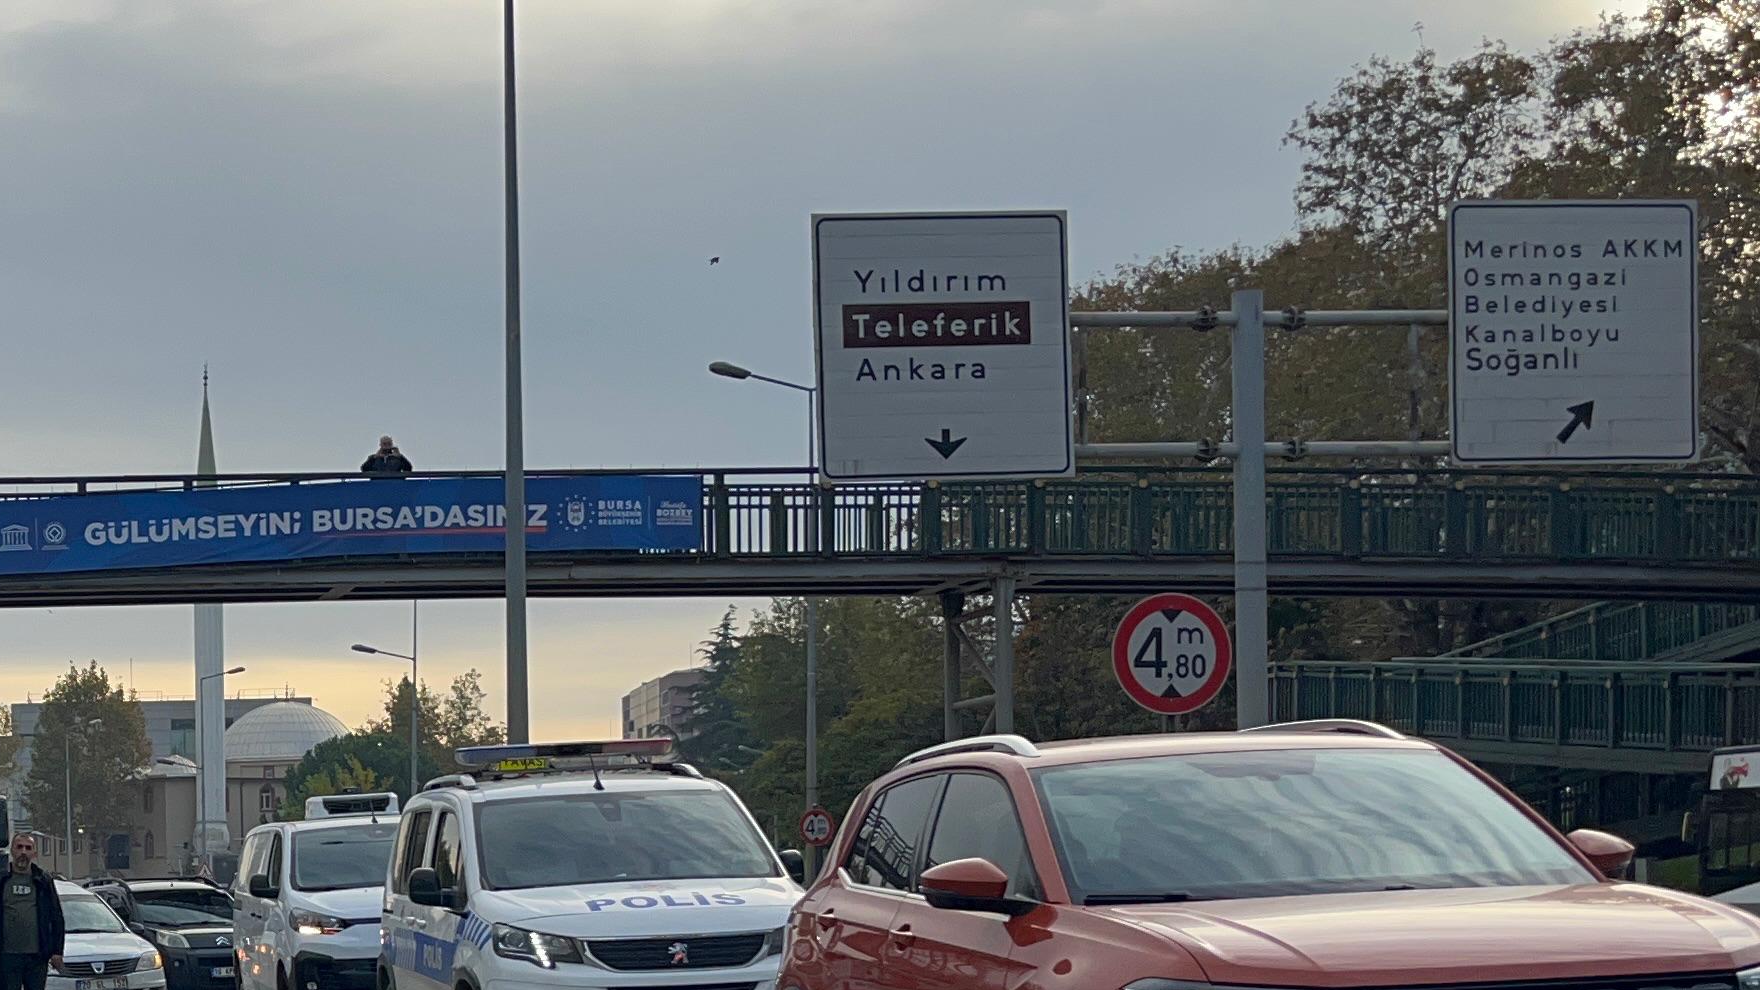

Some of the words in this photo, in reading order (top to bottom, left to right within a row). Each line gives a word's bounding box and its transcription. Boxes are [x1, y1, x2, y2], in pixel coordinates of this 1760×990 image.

[1464, 240, 1582, 259] Merinos
[1602, 239, 1683, 258] AKKM
[853, 269, 1007, 293] Yıldırım
[1463, 268, 1626, 291] Osmangazi
[1464, 295, 1618, 319] Belediyesi
[851, 311, 1032, 339] Teleferik
[1465, 323, 1620, 347] Kanalboyu
[855, 357, 987, 382] Ankara
[1466, 346, 1578, 377] Soğanlı
[598, 499, 642, 510] BURSA
[584, 891, 746, 912] POLİS
